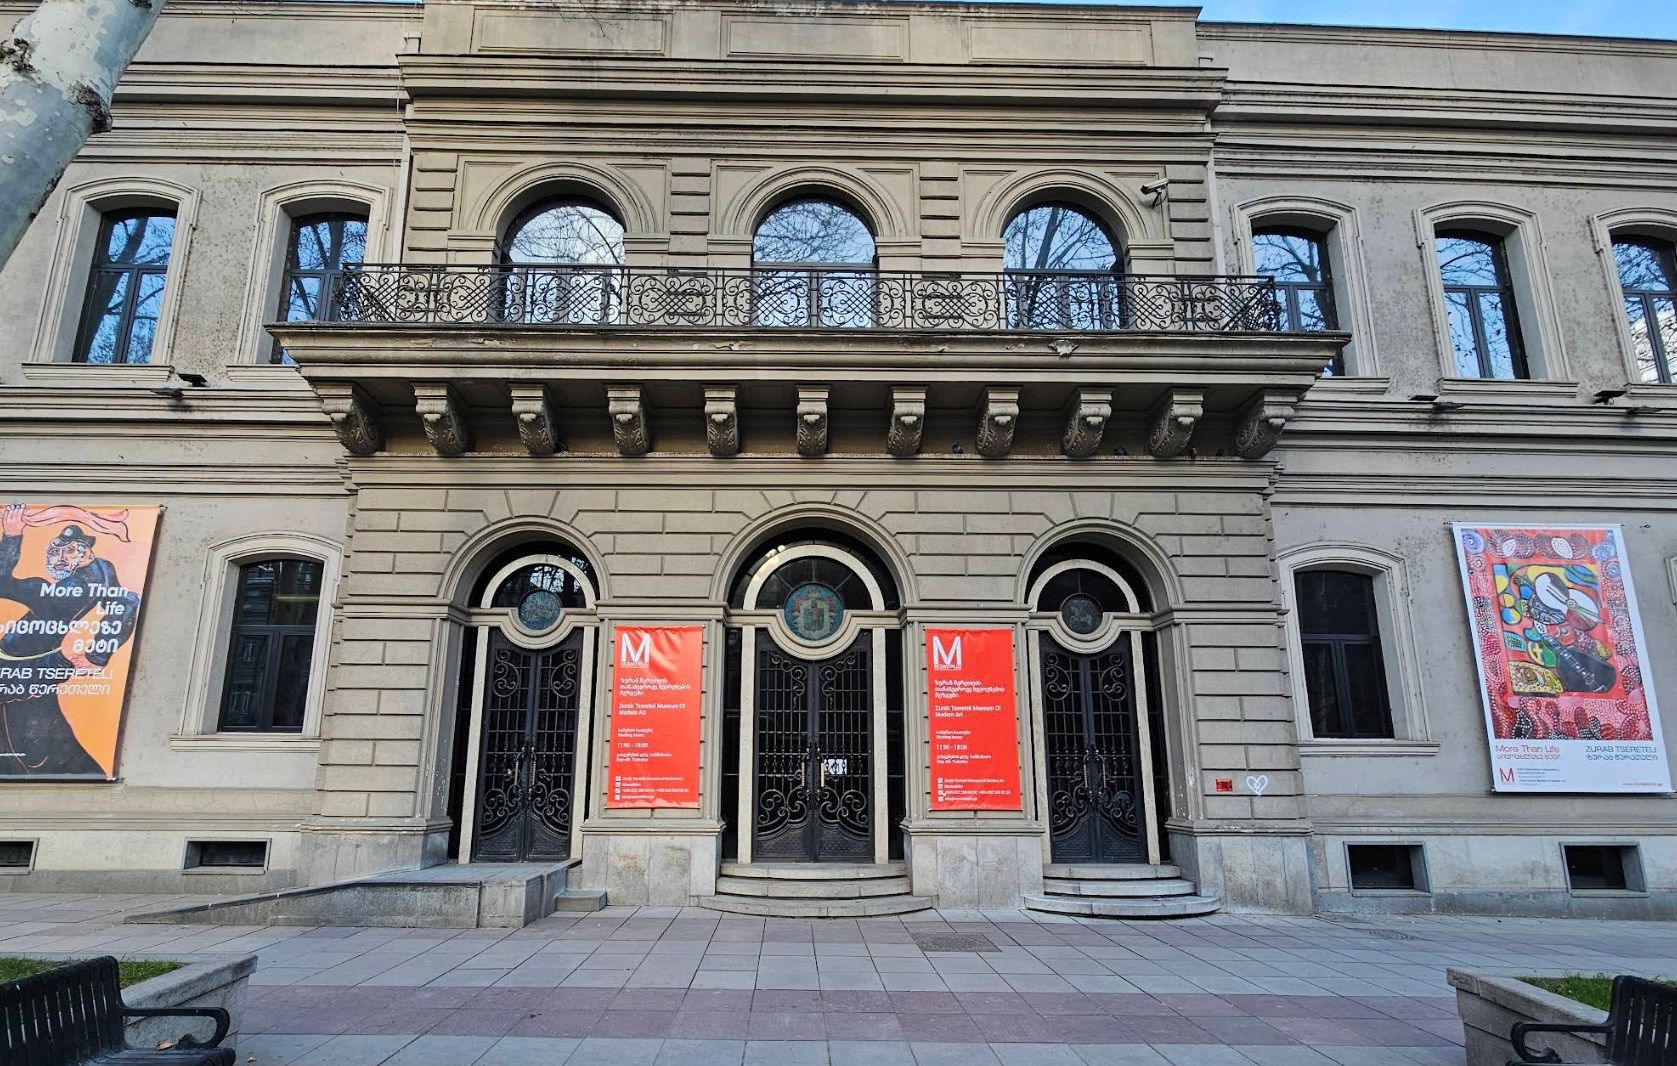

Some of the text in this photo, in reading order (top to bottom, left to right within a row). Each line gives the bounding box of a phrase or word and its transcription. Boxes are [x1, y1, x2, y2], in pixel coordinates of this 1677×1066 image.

[40, 583, 129, 597] More Than
[96, 601, 125, 615] Life
[73, 639, 118, 653] მეტი
[621, 632, 651, 662] M
[933, 635, 962, 665] M
[0, 667, 113, 680] RAB TSERETELI
[29, 683, 110, 695] წერეთელი
[1495, 744, 1560, 753] More Than Life
[1500, 767, 1515, 782] M
